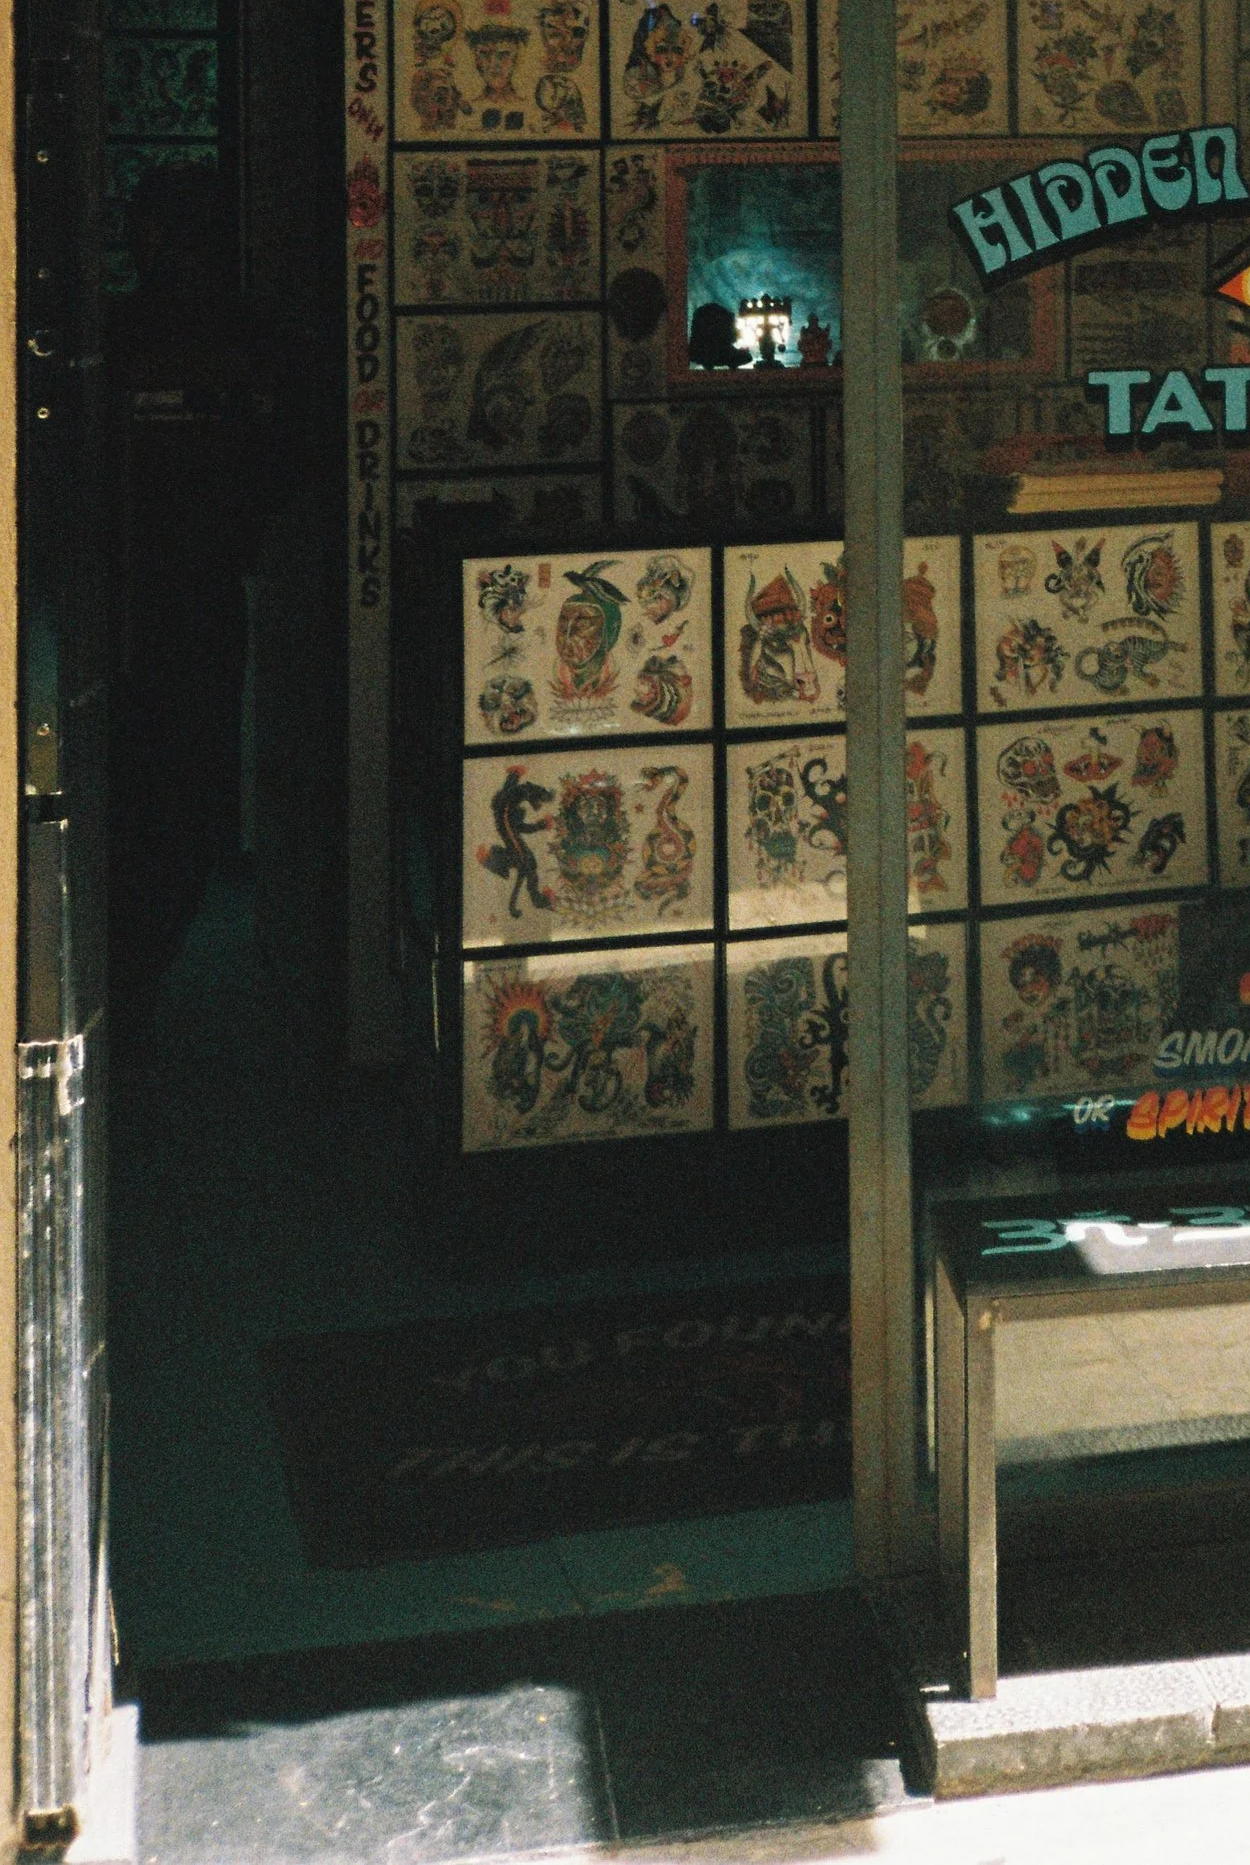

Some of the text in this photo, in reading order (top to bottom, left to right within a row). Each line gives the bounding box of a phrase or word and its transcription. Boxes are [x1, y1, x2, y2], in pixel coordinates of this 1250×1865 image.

[950, 124, 1249, 281] HIDDEN
[356, 263, 381, 383] FOOD
[356, 420, 382, 608] DRINKS
[1072, 1094, 1112, 1126] OR
